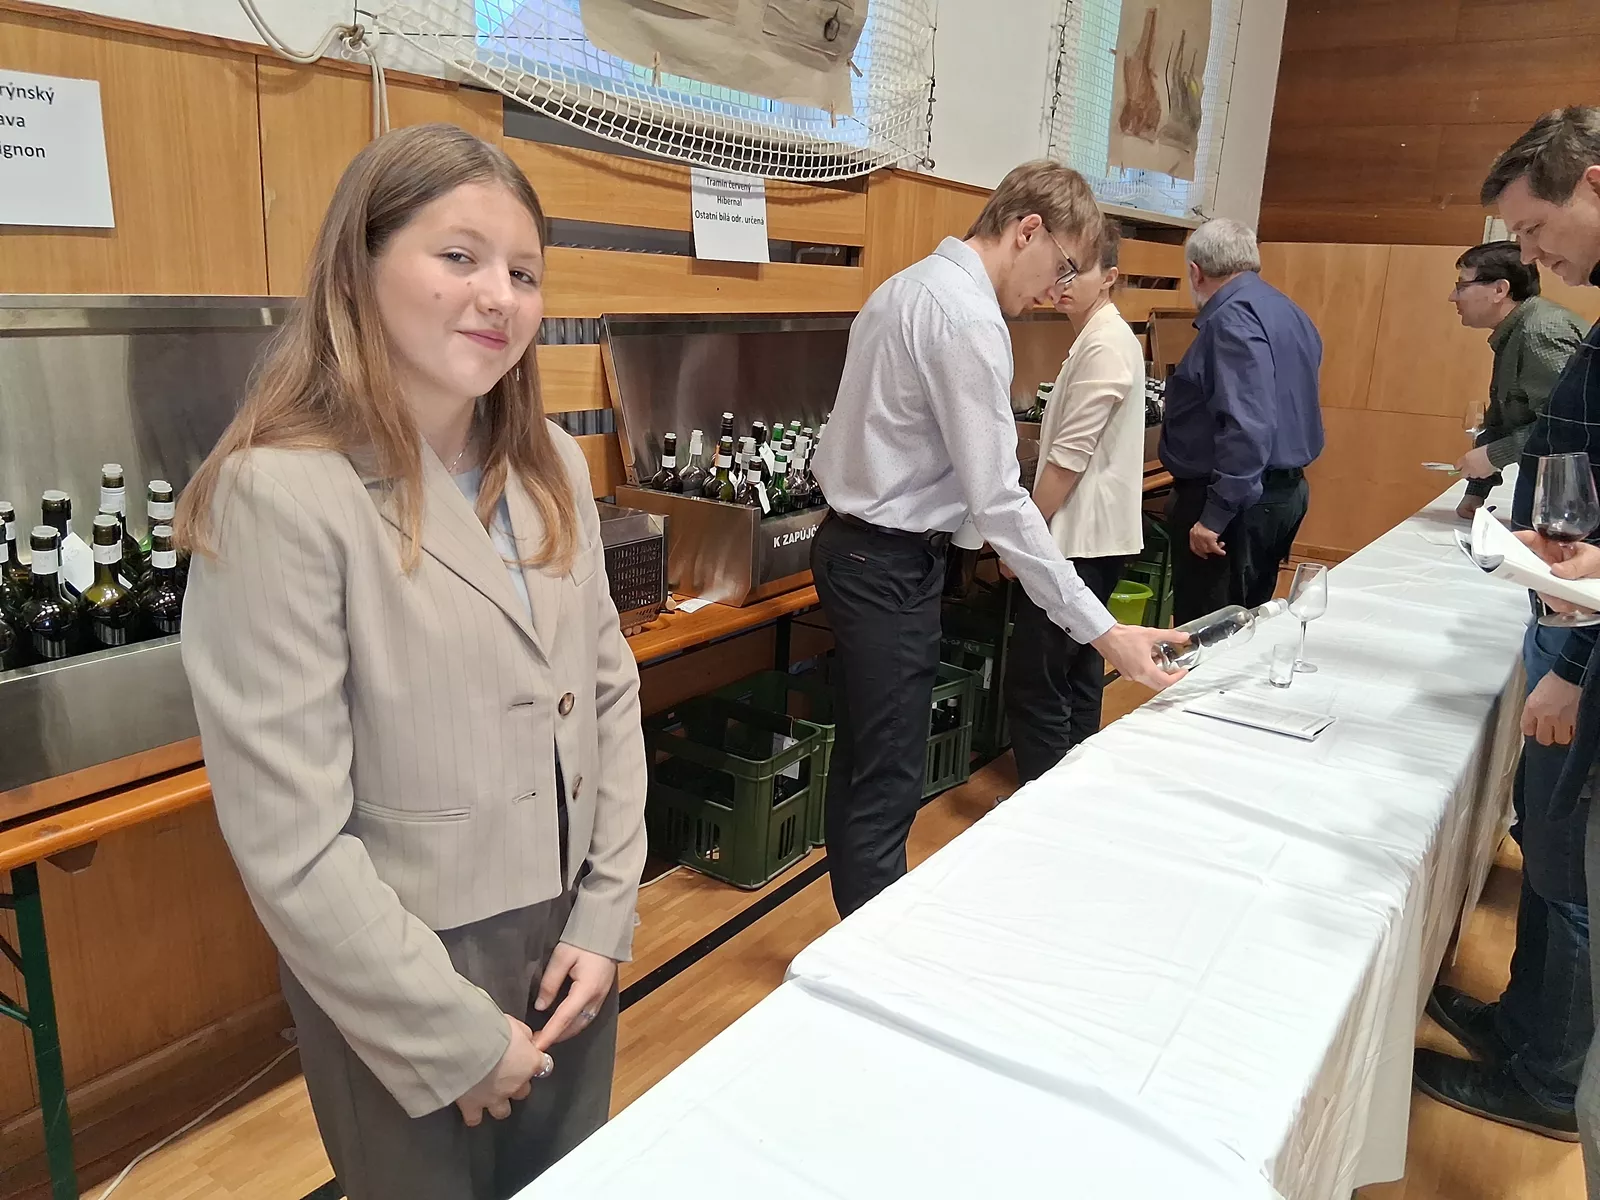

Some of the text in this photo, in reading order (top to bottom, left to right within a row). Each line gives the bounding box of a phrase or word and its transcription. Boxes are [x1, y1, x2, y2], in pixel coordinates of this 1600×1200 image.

[729, 180, 751, 193] červený
[717, 195, 742, 206] Hibernal
[695, 209, 718, 220] Ostatní
[731, 214, 744, 223] odr.
[745, 216, 764, 225] určená
[773, 524, 819, 548] K ZAPŮJČ
